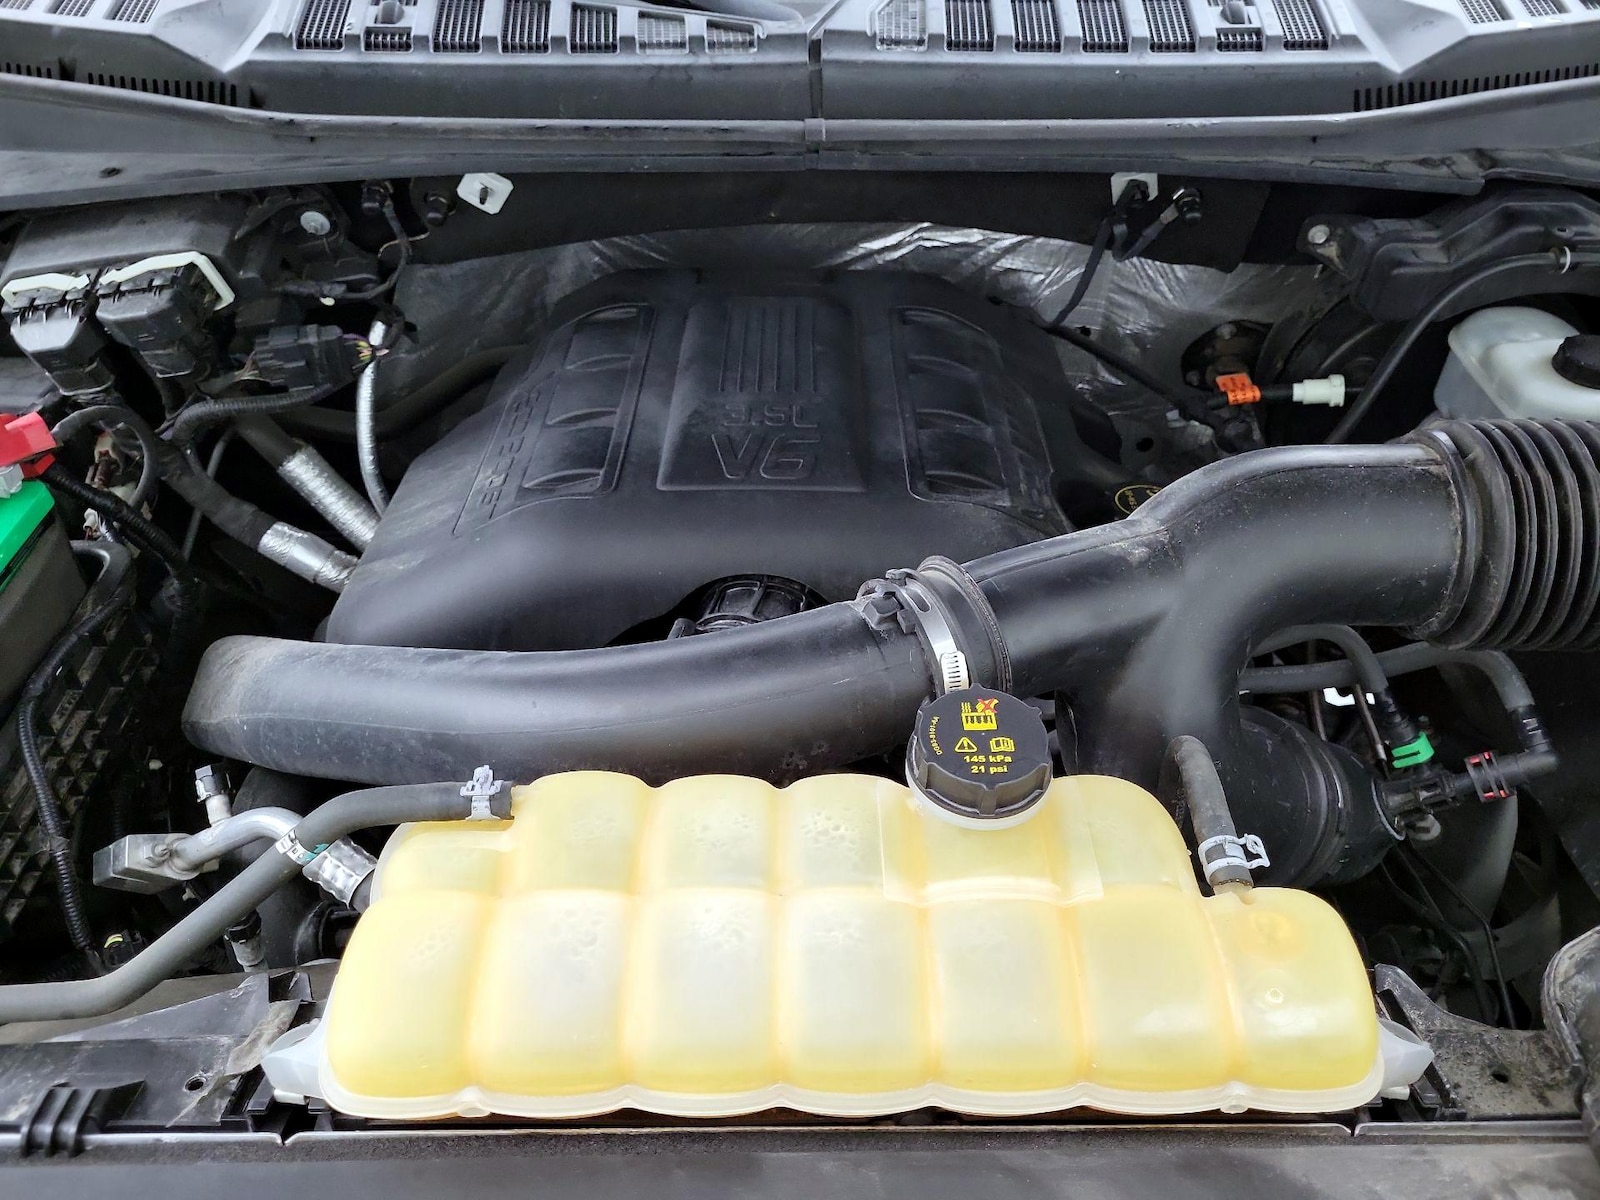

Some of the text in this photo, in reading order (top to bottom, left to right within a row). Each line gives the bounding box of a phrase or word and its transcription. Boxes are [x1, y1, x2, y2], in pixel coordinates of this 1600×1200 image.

[722, 403, 819, 429] 3.5L
[711, 433, 823, 480] V6
[963, 754, 1013, 763] 145 kPa
[970, 764, 1009, 775] 21 psi
